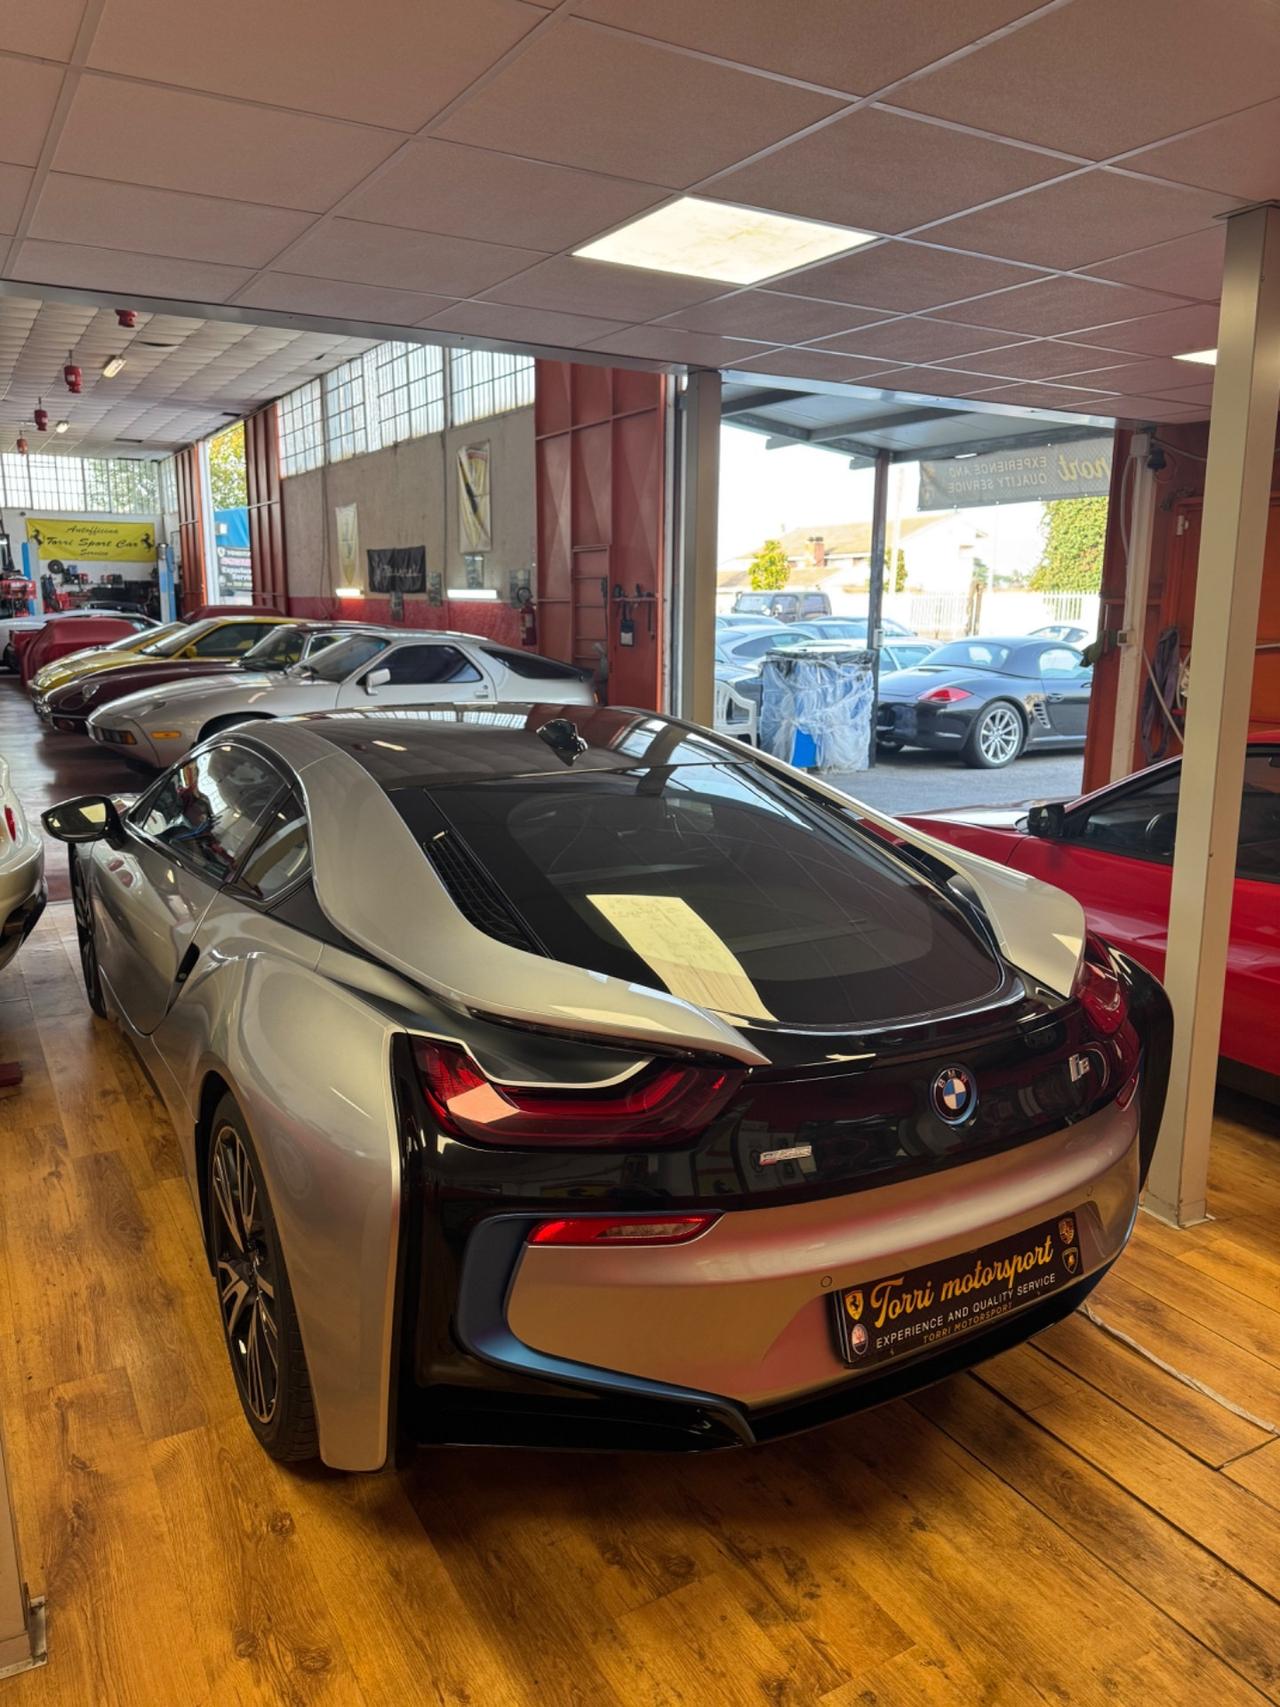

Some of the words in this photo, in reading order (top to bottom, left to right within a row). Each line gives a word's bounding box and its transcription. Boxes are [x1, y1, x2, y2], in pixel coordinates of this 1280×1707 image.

[46, 537, 74, 546] Torri
[78, 538, 112, 548] Sport
[116, 539, 139, 548] Car
[937, 1069, 969, 1089] BMW
[870, 1276, 935, 1329] Torri
[941, 1234, 1054, 1300] motorsport
[876, 1316, 943, 1349] EXPERIENCE
[947, 1307, 969, 1329] AND
[972, 1289, 1014, 1313] QUALITY
[1017, 1273, 1056, 1296] SERVICE
[923, 1328, 951, 1344] TORRI
[954, 1302, 1013, 1332] MOTORSPORT
